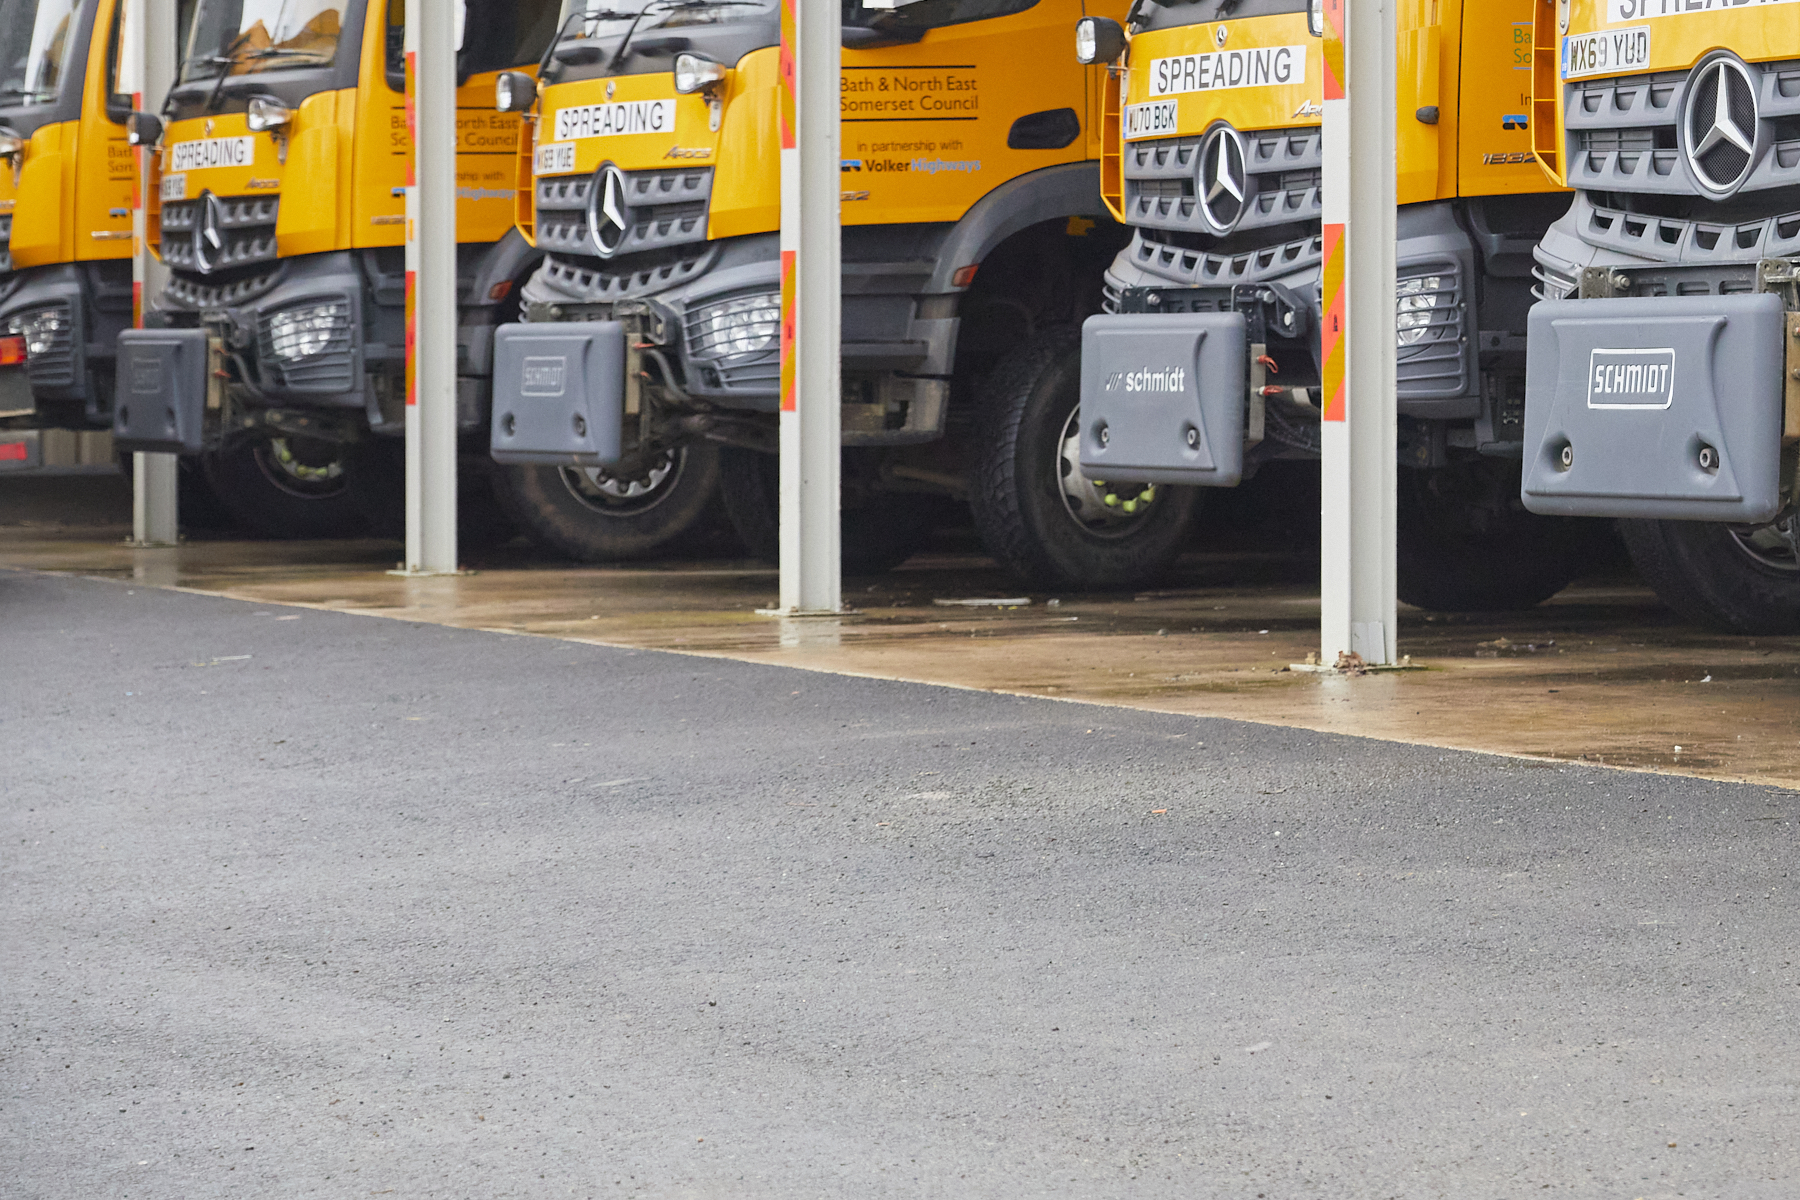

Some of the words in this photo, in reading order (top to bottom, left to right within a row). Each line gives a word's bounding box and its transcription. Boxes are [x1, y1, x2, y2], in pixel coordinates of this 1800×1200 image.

[1570, 36, 1608, 72] WX69
[1613, 31, 1647, 66] YUD
[878, 76, 890, 92] &
[893, 76, 943, 91] North
[946, 75, 977, 91] East
[1157, 47, 1292, 94] SPREADING
[919, 95, 979, 111] Council
[1154, 103, 1176, 130] BGK
[560, 101, 664, 138] SPREADING
[174, 139, 245, 169] SPREADING
[871, 140, 937, 154] partnership
[939, 139, 964, 151] with
[1125, 366, 1185, 392] schmidt
[1594, 364, 1669, 393] SCHMIDT
